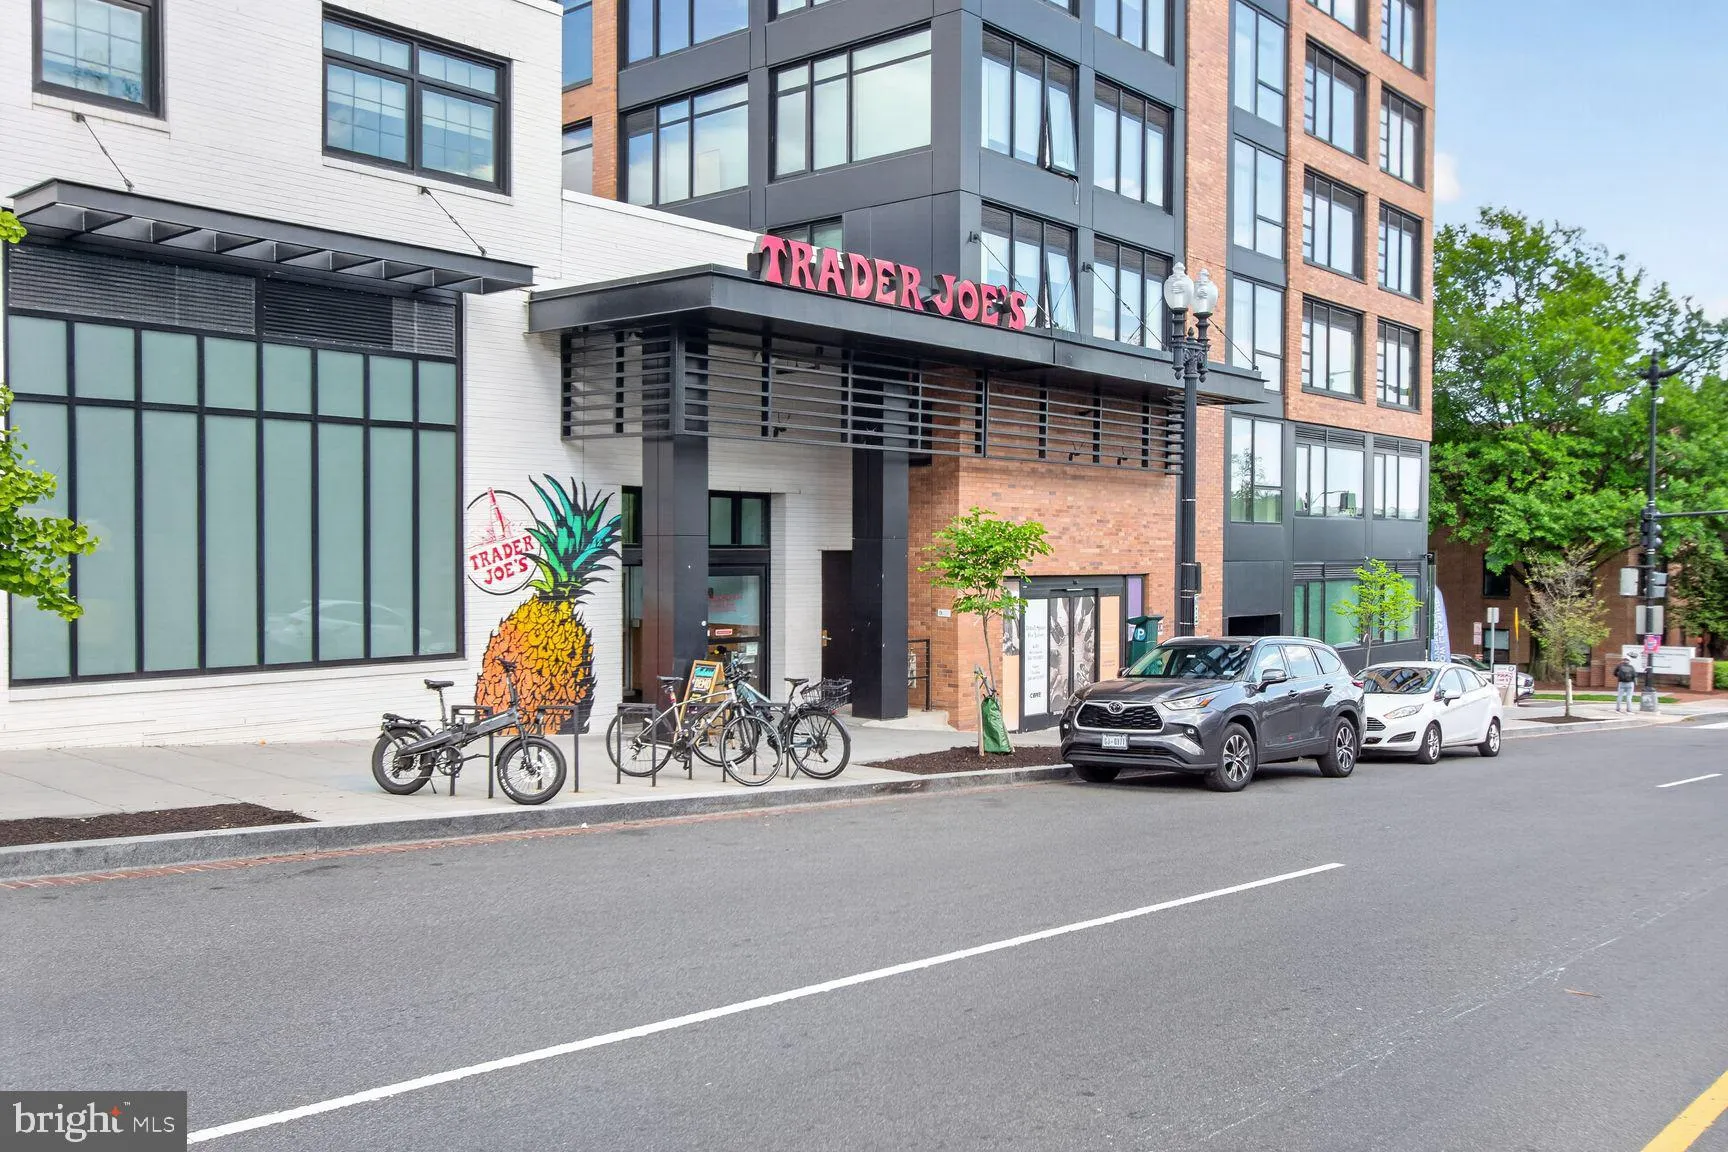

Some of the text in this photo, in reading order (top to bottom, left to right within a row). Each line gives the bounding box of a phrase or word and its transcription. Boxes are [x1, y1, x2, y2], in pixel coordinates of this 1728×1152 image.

[760, 234, 1028, 332] TRADER JOE'S
[469, 535, 534, 571] TRADER
[484, 556, 529, 585] JOE'S
